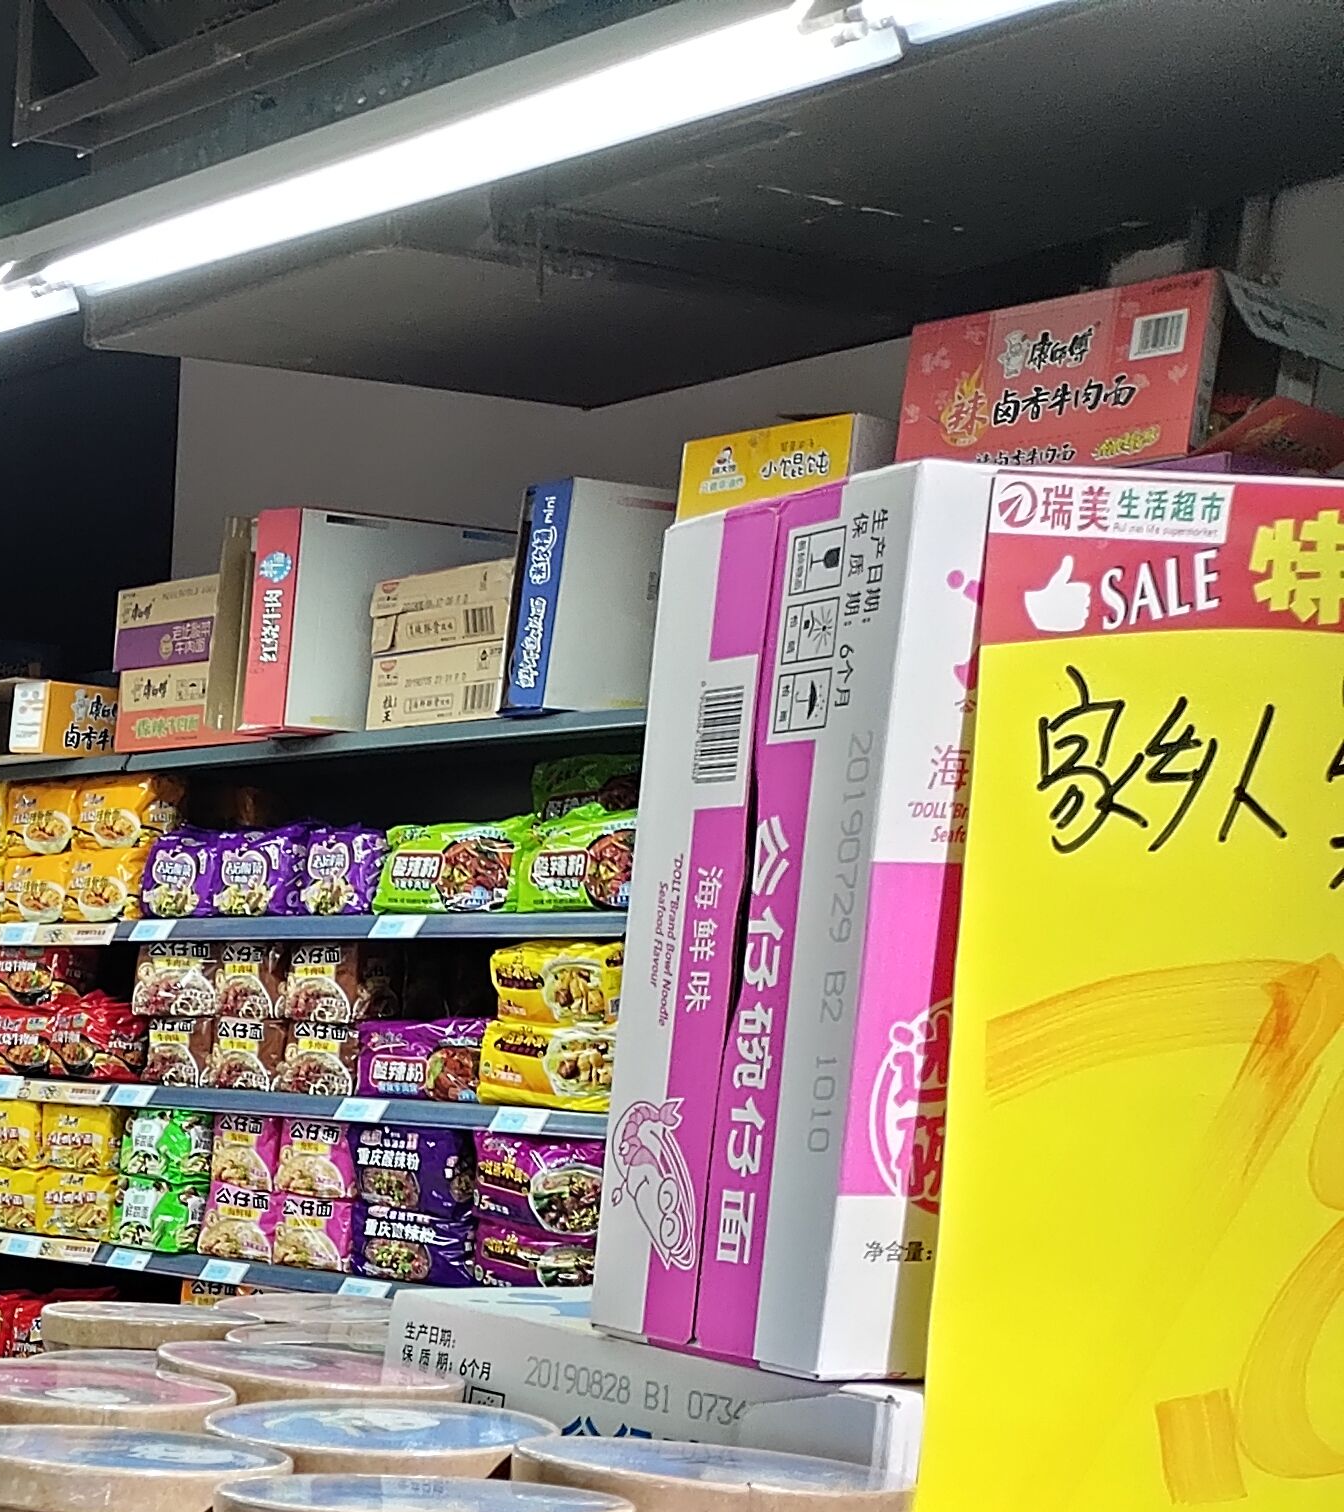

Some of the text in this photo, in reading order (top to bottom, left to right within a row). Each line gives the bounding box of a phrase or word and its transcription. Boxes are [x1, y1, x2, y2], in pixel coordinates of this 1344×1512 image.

[992, 375, 1136, 426] 卤香牛肉面
[544, 496, 556, 523] mini
[1040, 485, 1226, 532] 瑞美生活超市
[1100, 548, 1222, 630] SALE
[1248, 509, 1344, 626] 特
[65, 725, 115, 749] 卤香牛
[1037, 665, 1344, 856] 家乡人
[907, 801, 968, 820] "DOLL"Br
[654, 880, 669, 934] Seafood
[684, 865, 724, 1014] 海鲜味
[807, 730, 875, 1154] 20190729 B2 1010
[715, 814, 793, 1266] 公仔碗仔面
[219, 1114, 263, 1134] 公仔面
[290, 1122, 340, 1144] 公仔面
[357, 1148, 419, 1171] 重庆酸辣粉
[216, 1187, 269, 1211] 公仔面
[525, 1356, 670, 1413] 20190828 B1
